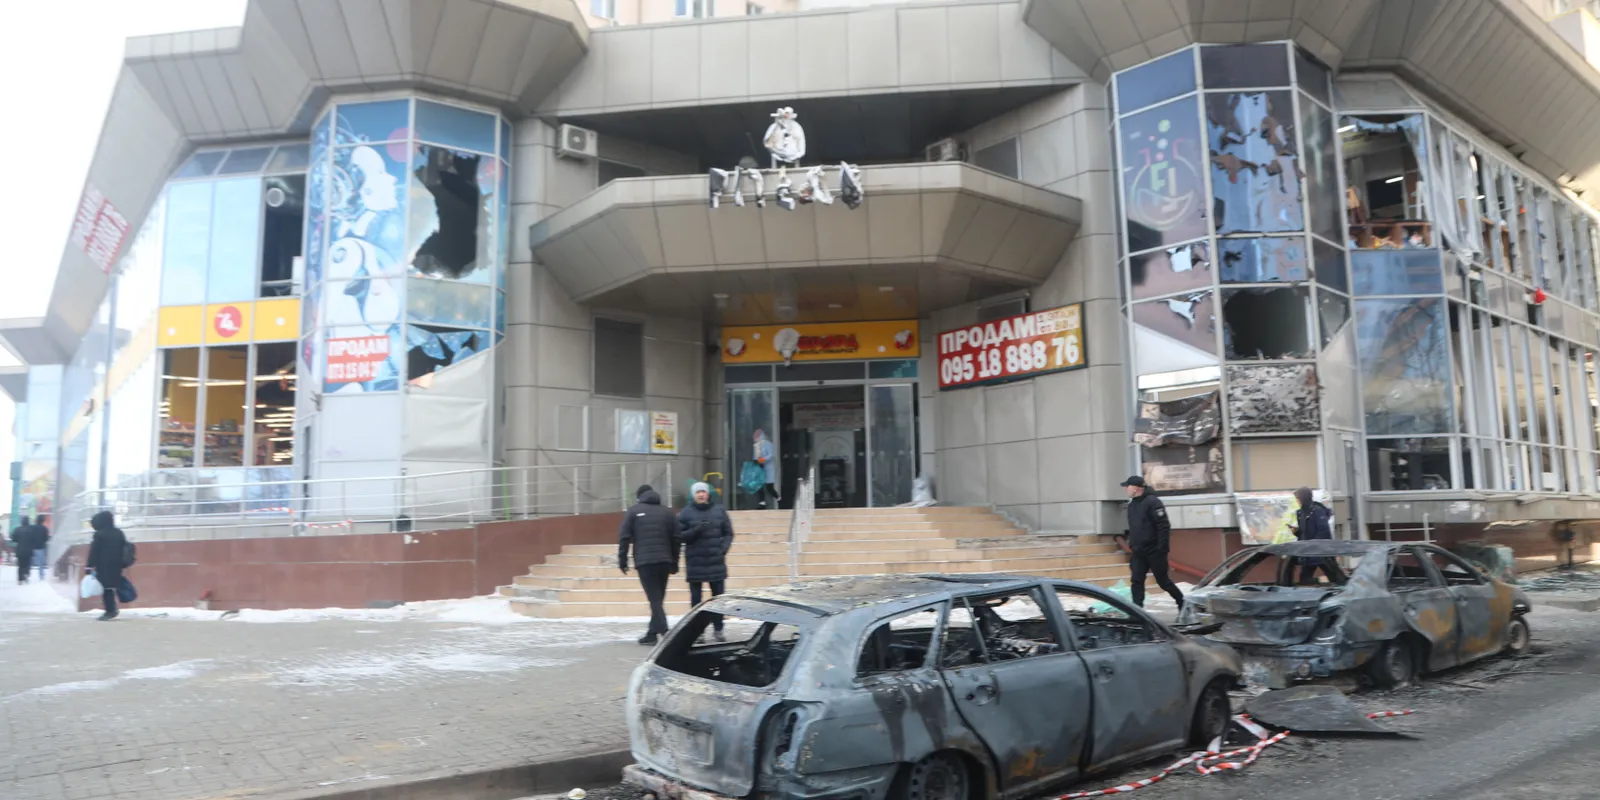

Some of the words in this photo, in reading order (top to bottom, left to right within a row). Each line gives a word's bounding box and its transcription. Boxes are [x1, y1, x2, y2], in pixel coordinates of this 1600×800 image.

[327, 338, 388, 357] ПРОДАМ
[941, 315, 1036, 354] ПРОДАМ
[941, 354, 975, 384] 095
[978, 348, 1002, 378] 18
[1005, 340, 1047, 373] 888
[1051, 334, 1080, 366] 76
